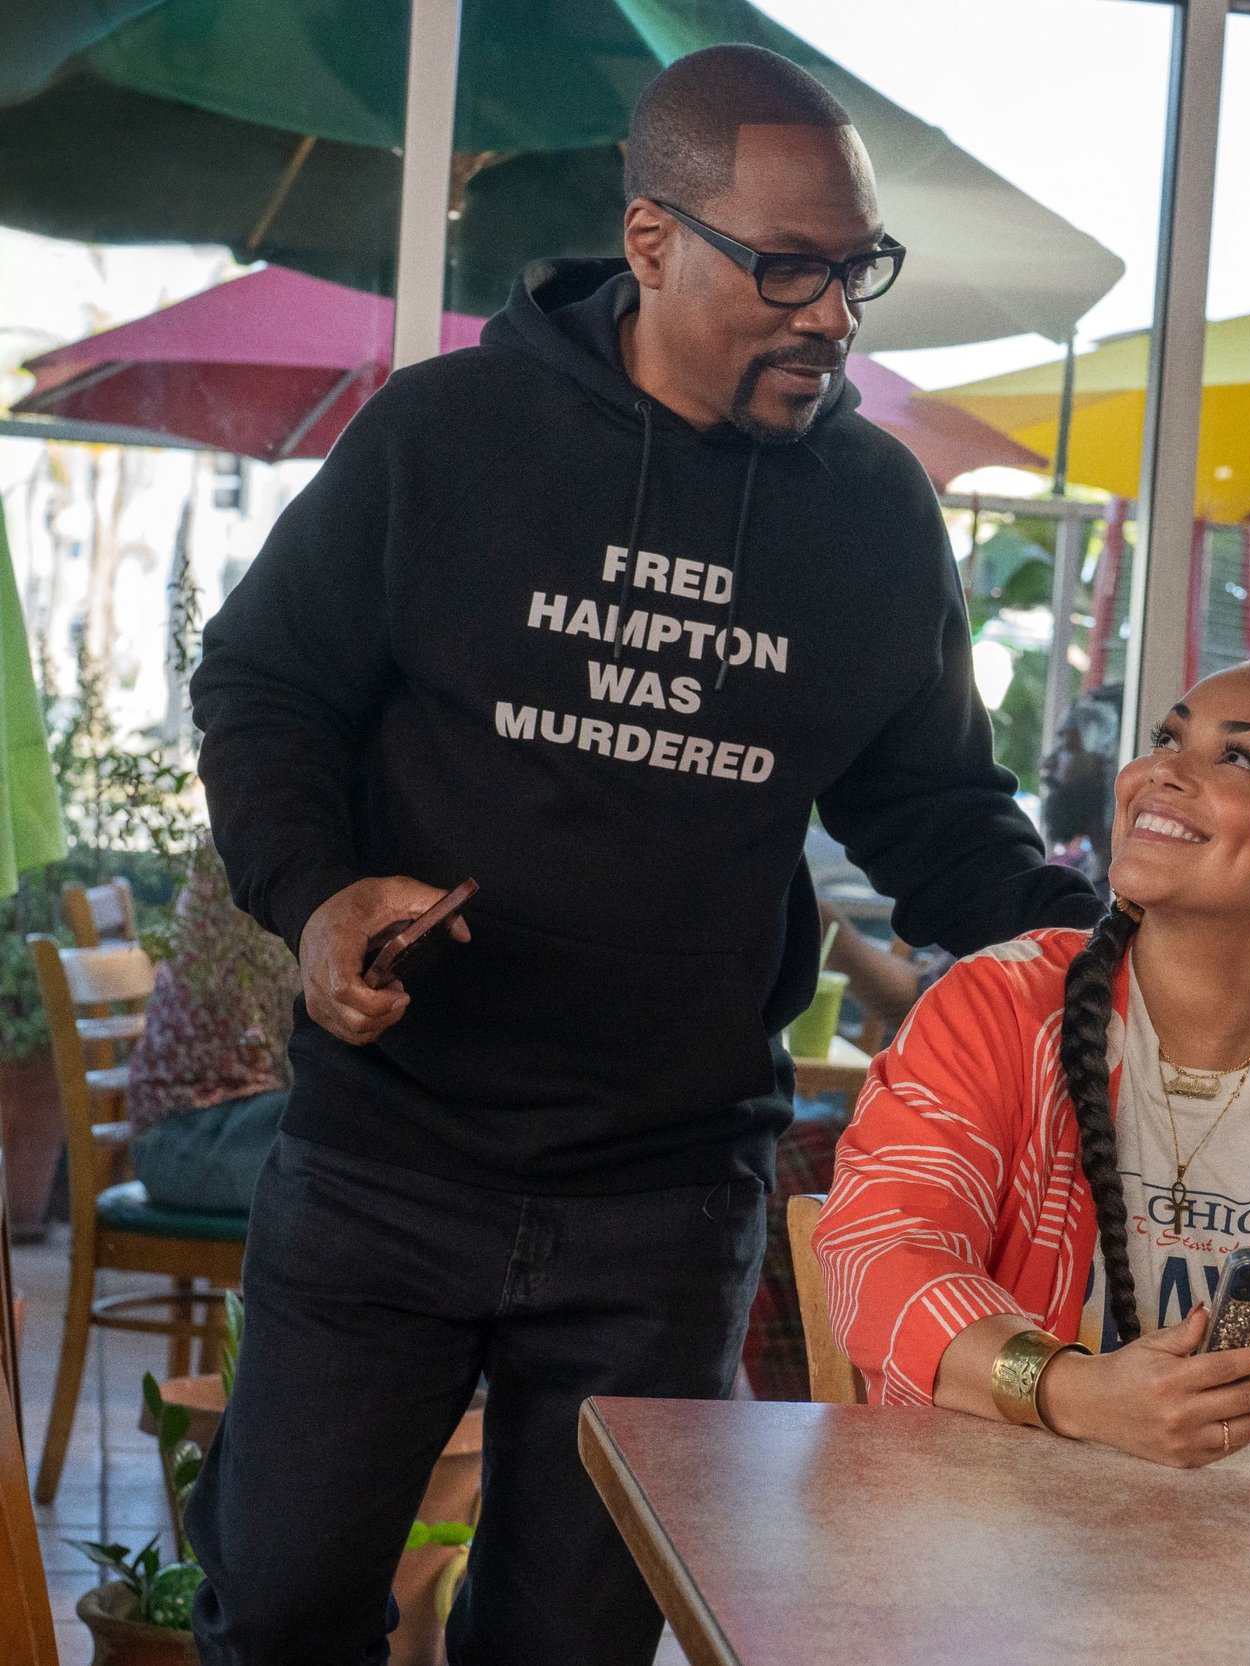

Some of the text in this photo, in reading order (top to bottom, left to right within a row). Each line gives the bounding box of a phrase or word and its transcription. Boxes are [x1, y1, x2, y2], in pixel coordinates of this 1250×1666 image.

[602, 545, 734, 605] FRED
[527, 591, 789, 673] HAMPTON
[588, 660, 702, 714] WAS
[495, 701, 775, 783] MURDERED
